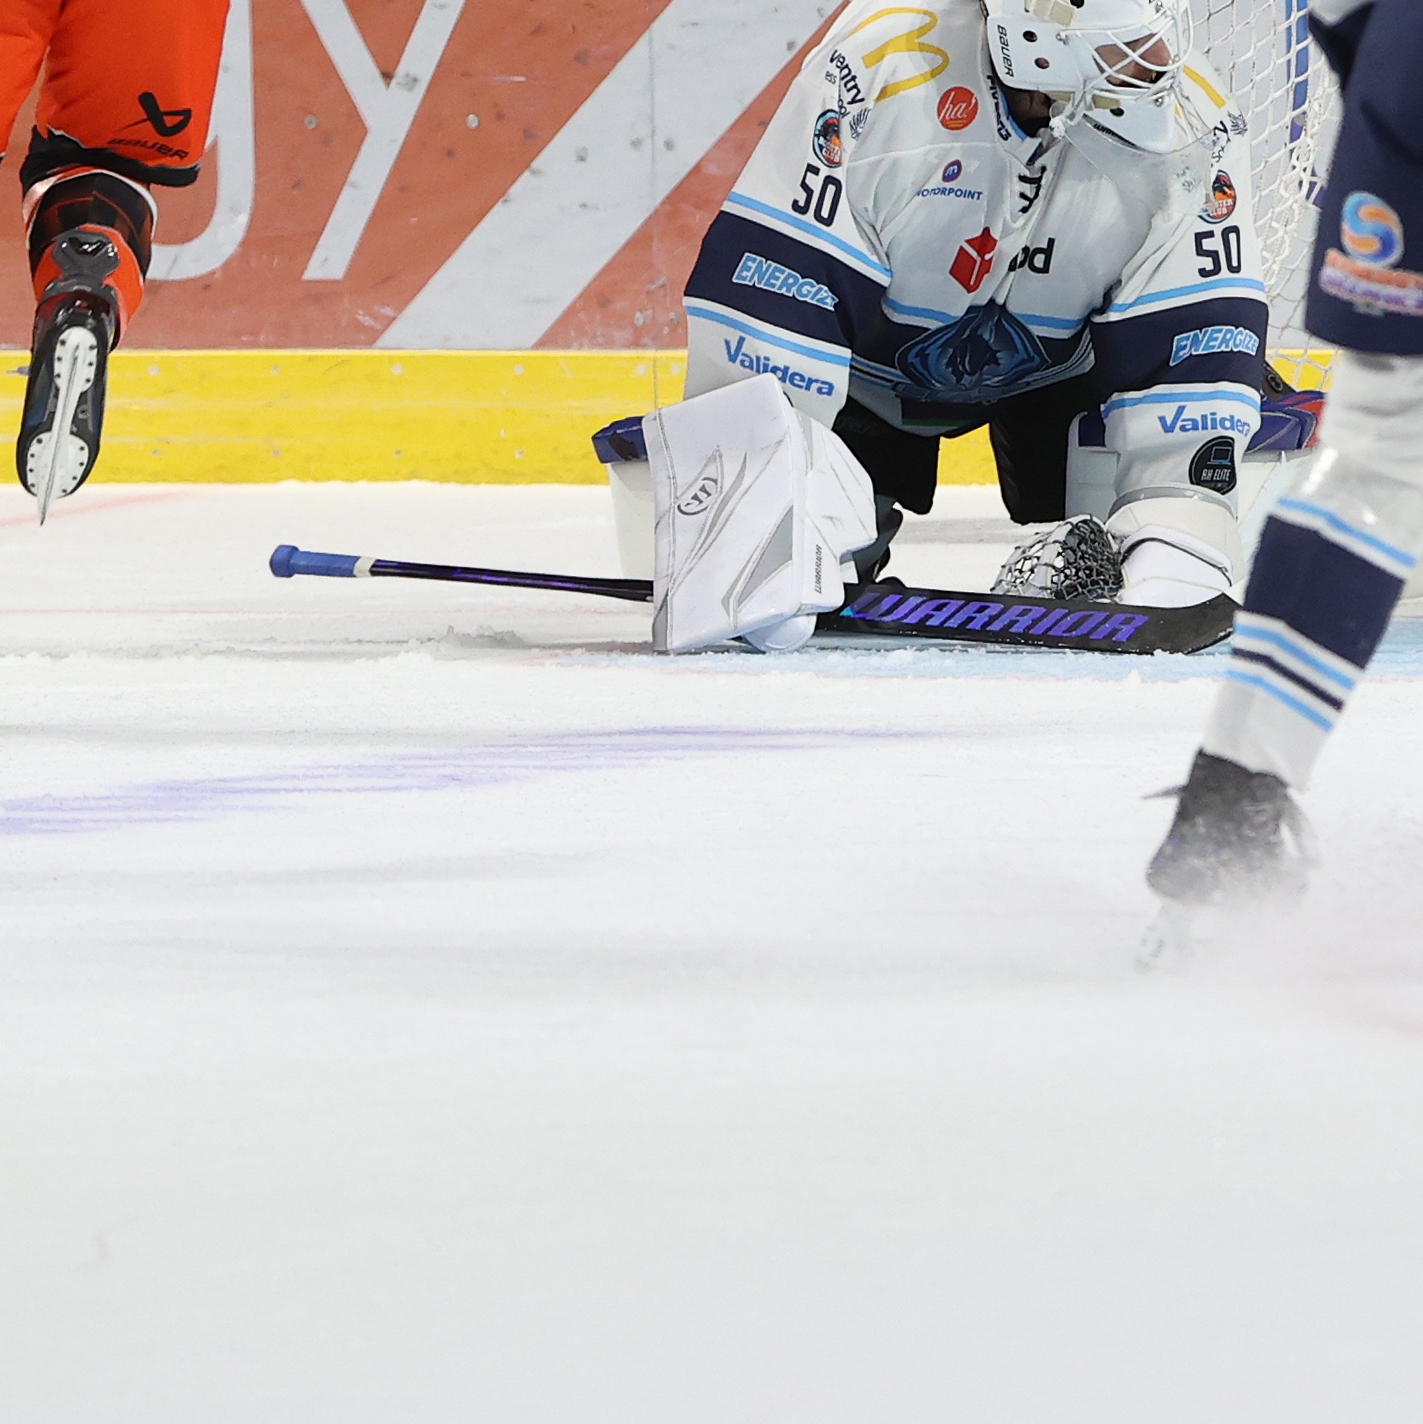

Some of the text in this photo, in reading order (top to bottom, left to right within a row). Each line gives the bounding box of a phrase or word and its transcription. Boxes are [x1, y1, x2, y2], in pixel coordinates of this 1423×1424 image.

[997, 24, 1015, 78] BAUER
[107, 137, 189, 160] BAUER
[791, 163, 843, 228] 50
[1194, 226, 1243, 278] 50
[724, 335, 835, 399] Validera
[1170, 325, 1260, 368] ENERGIZE
[813, 544, 823, 595] WARRIOR
[841, 590, 1148, 645] WARRIOR
